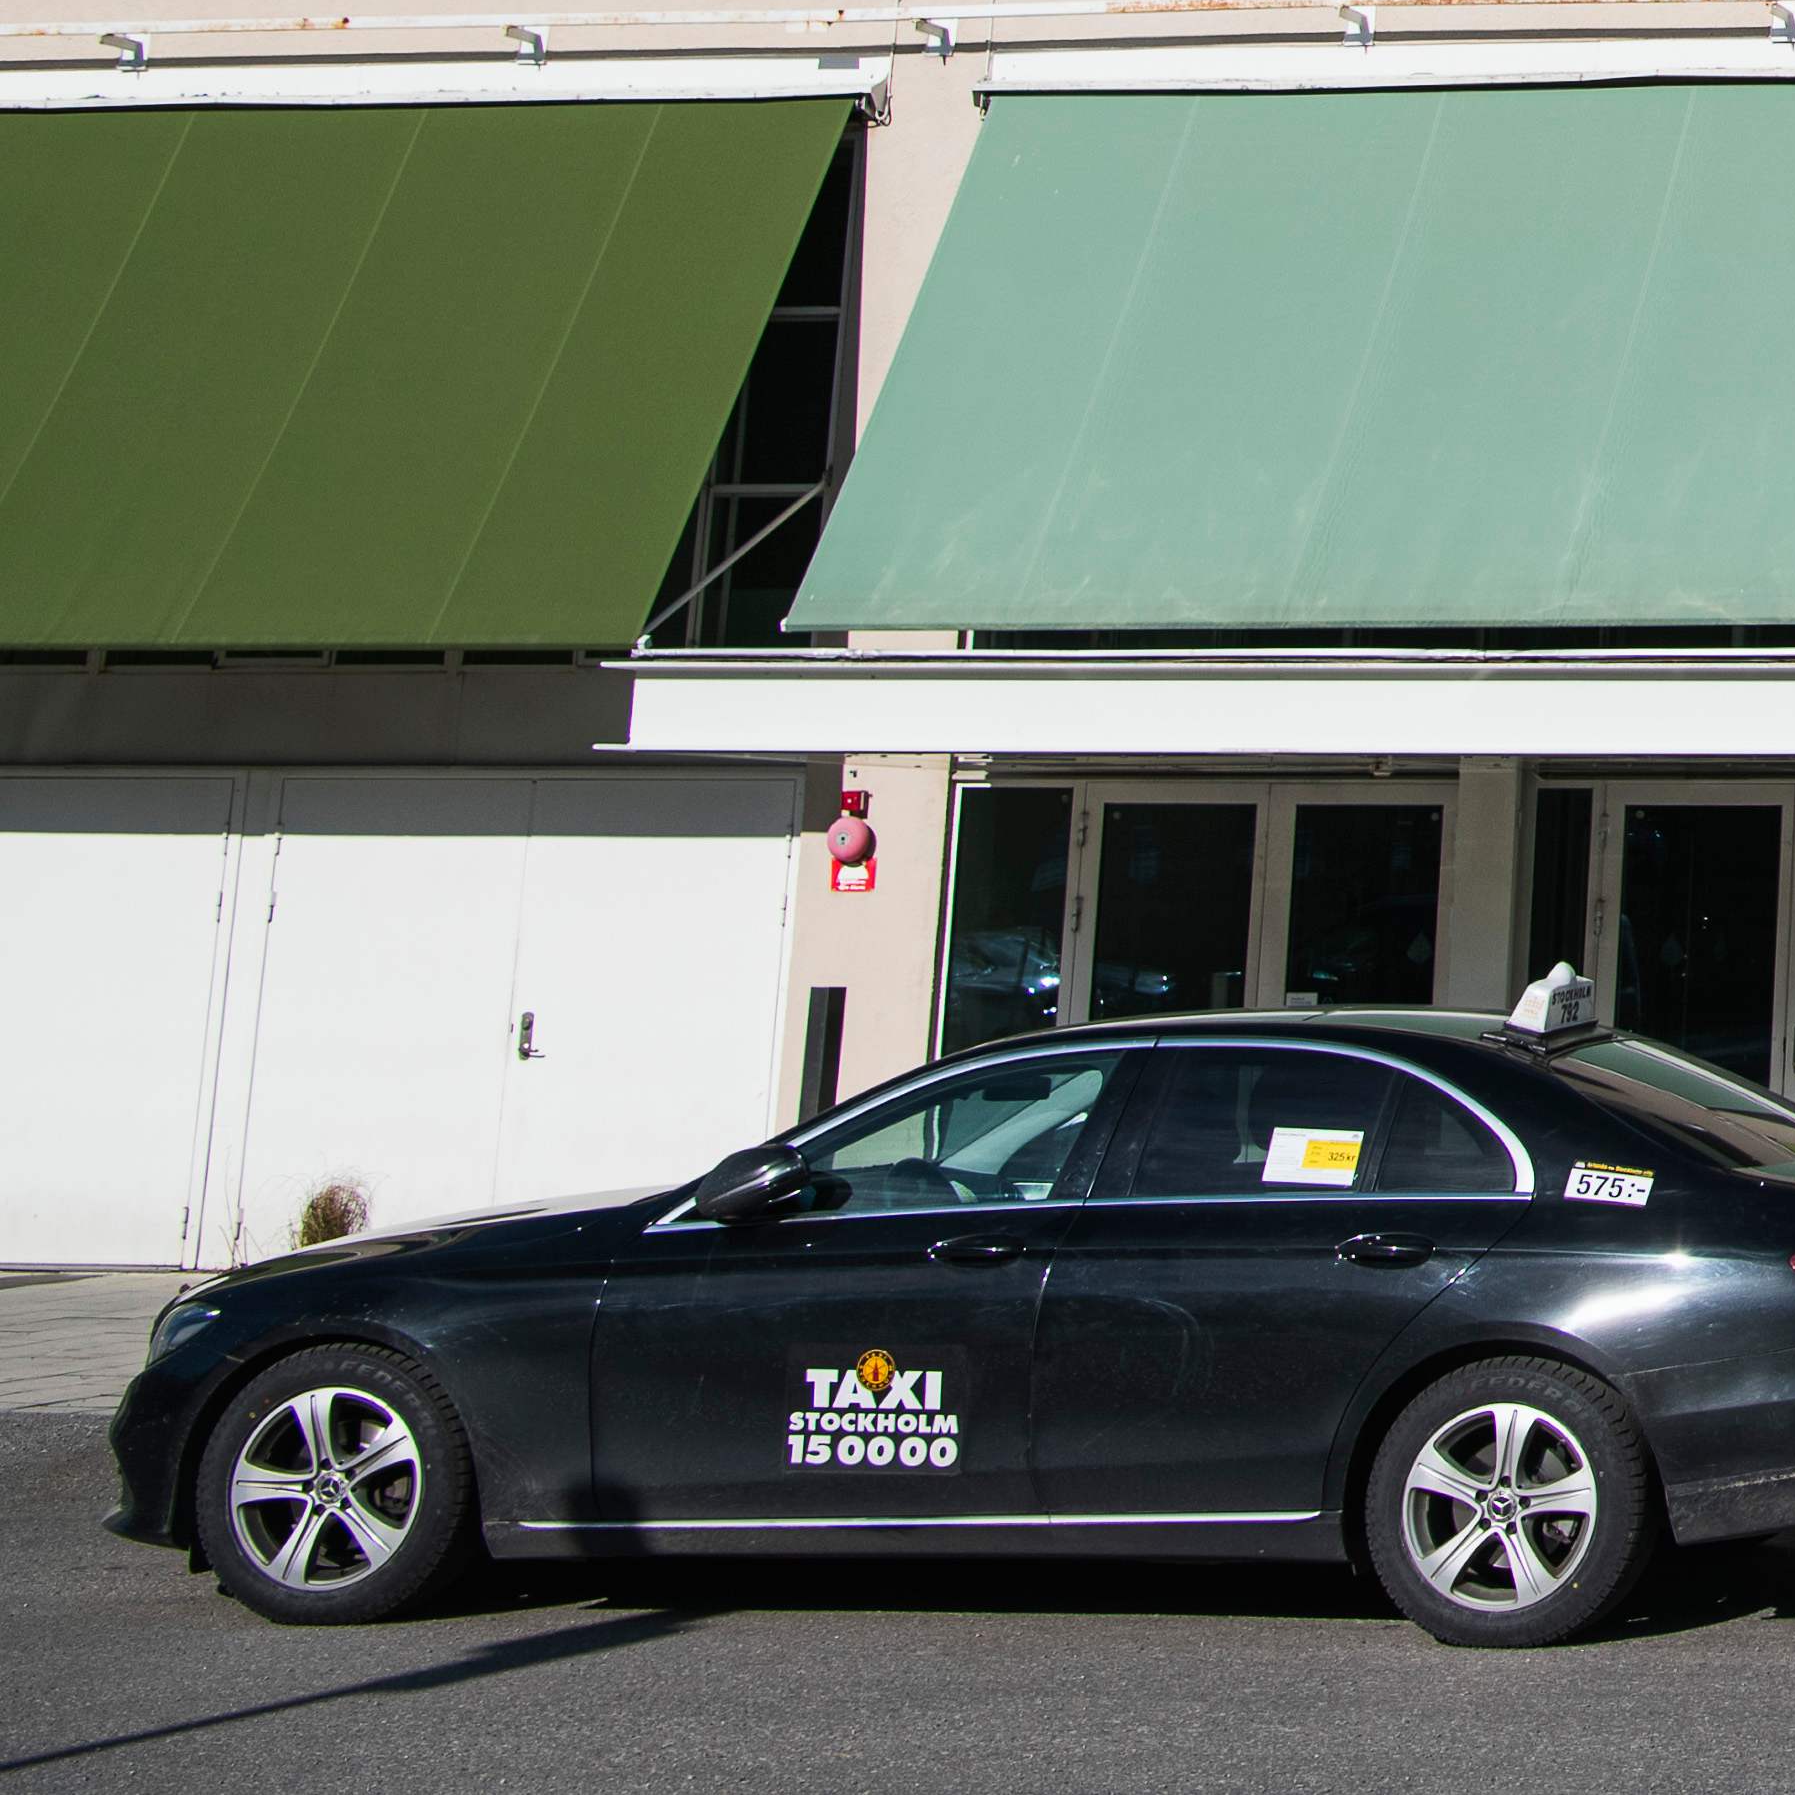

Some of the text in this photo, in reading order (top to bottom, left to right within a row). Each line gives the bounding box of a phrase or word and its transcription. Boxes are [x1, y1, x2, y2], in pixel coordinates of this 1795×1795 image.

[1576, 1174, 1646, 1198] 575:-
[805, 1368, 943, 1410] TAXI
[788, 1412, 959, 1434] STOCKHOLM
